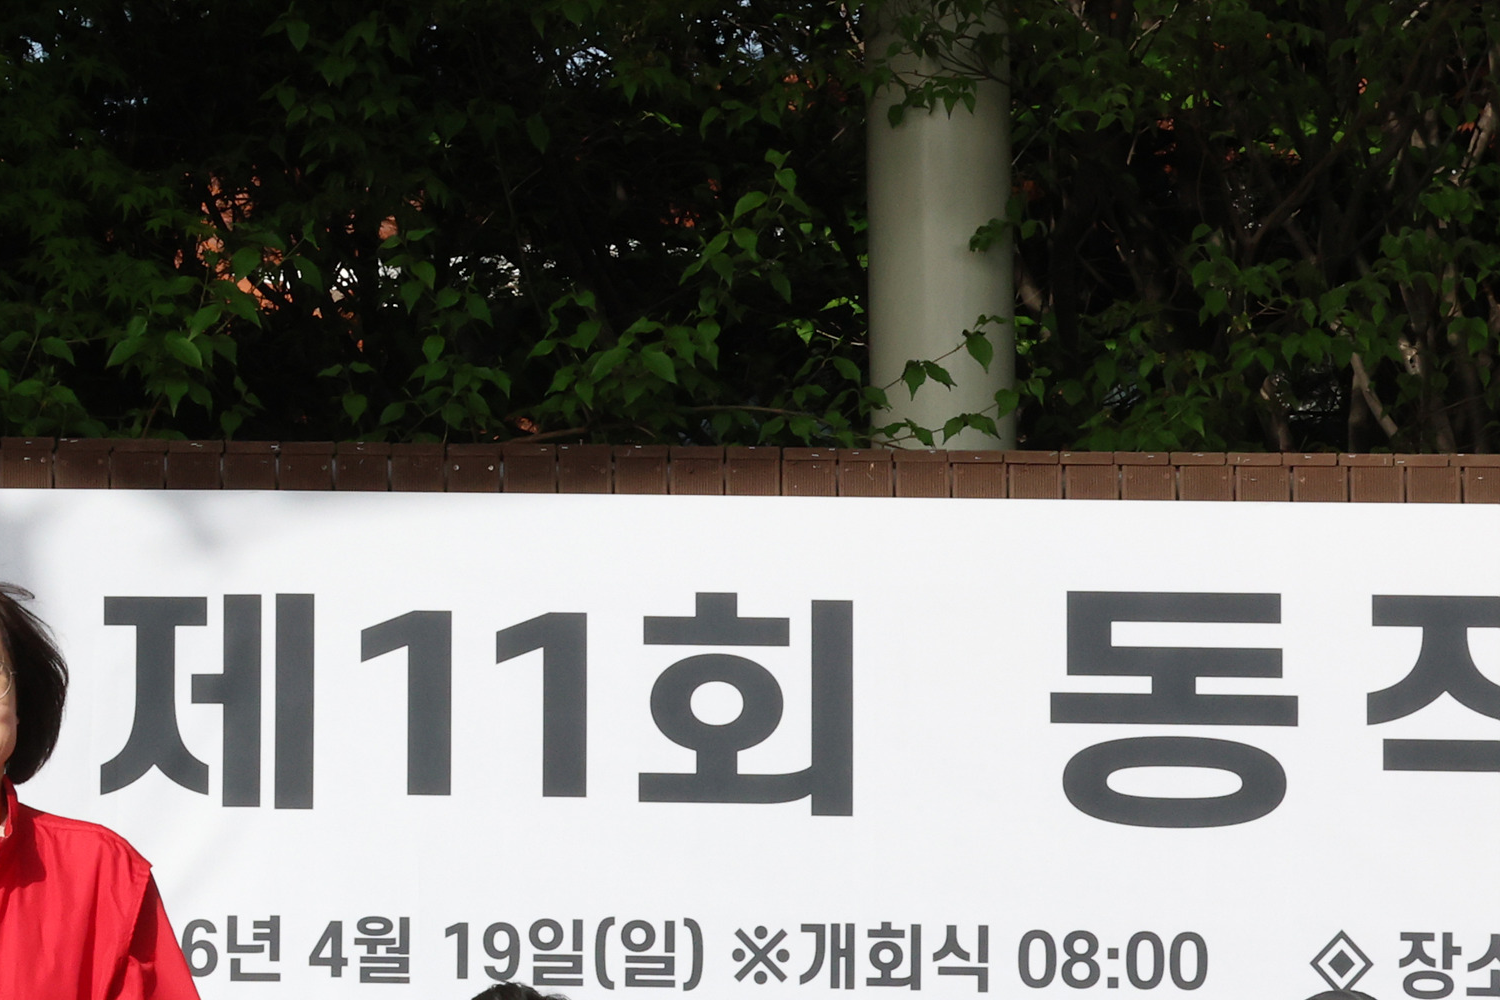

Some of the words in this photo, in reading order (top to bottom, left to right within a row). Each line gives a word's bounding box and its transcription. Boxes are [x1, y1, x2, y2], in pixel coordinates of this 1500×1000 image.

[100, 591, 854, 817] 제11회
[308, 915, 411, 984] 4월
[444, 916, 704, 991] 19일(일)
[1017, 929, 1209, 991] 08:00
